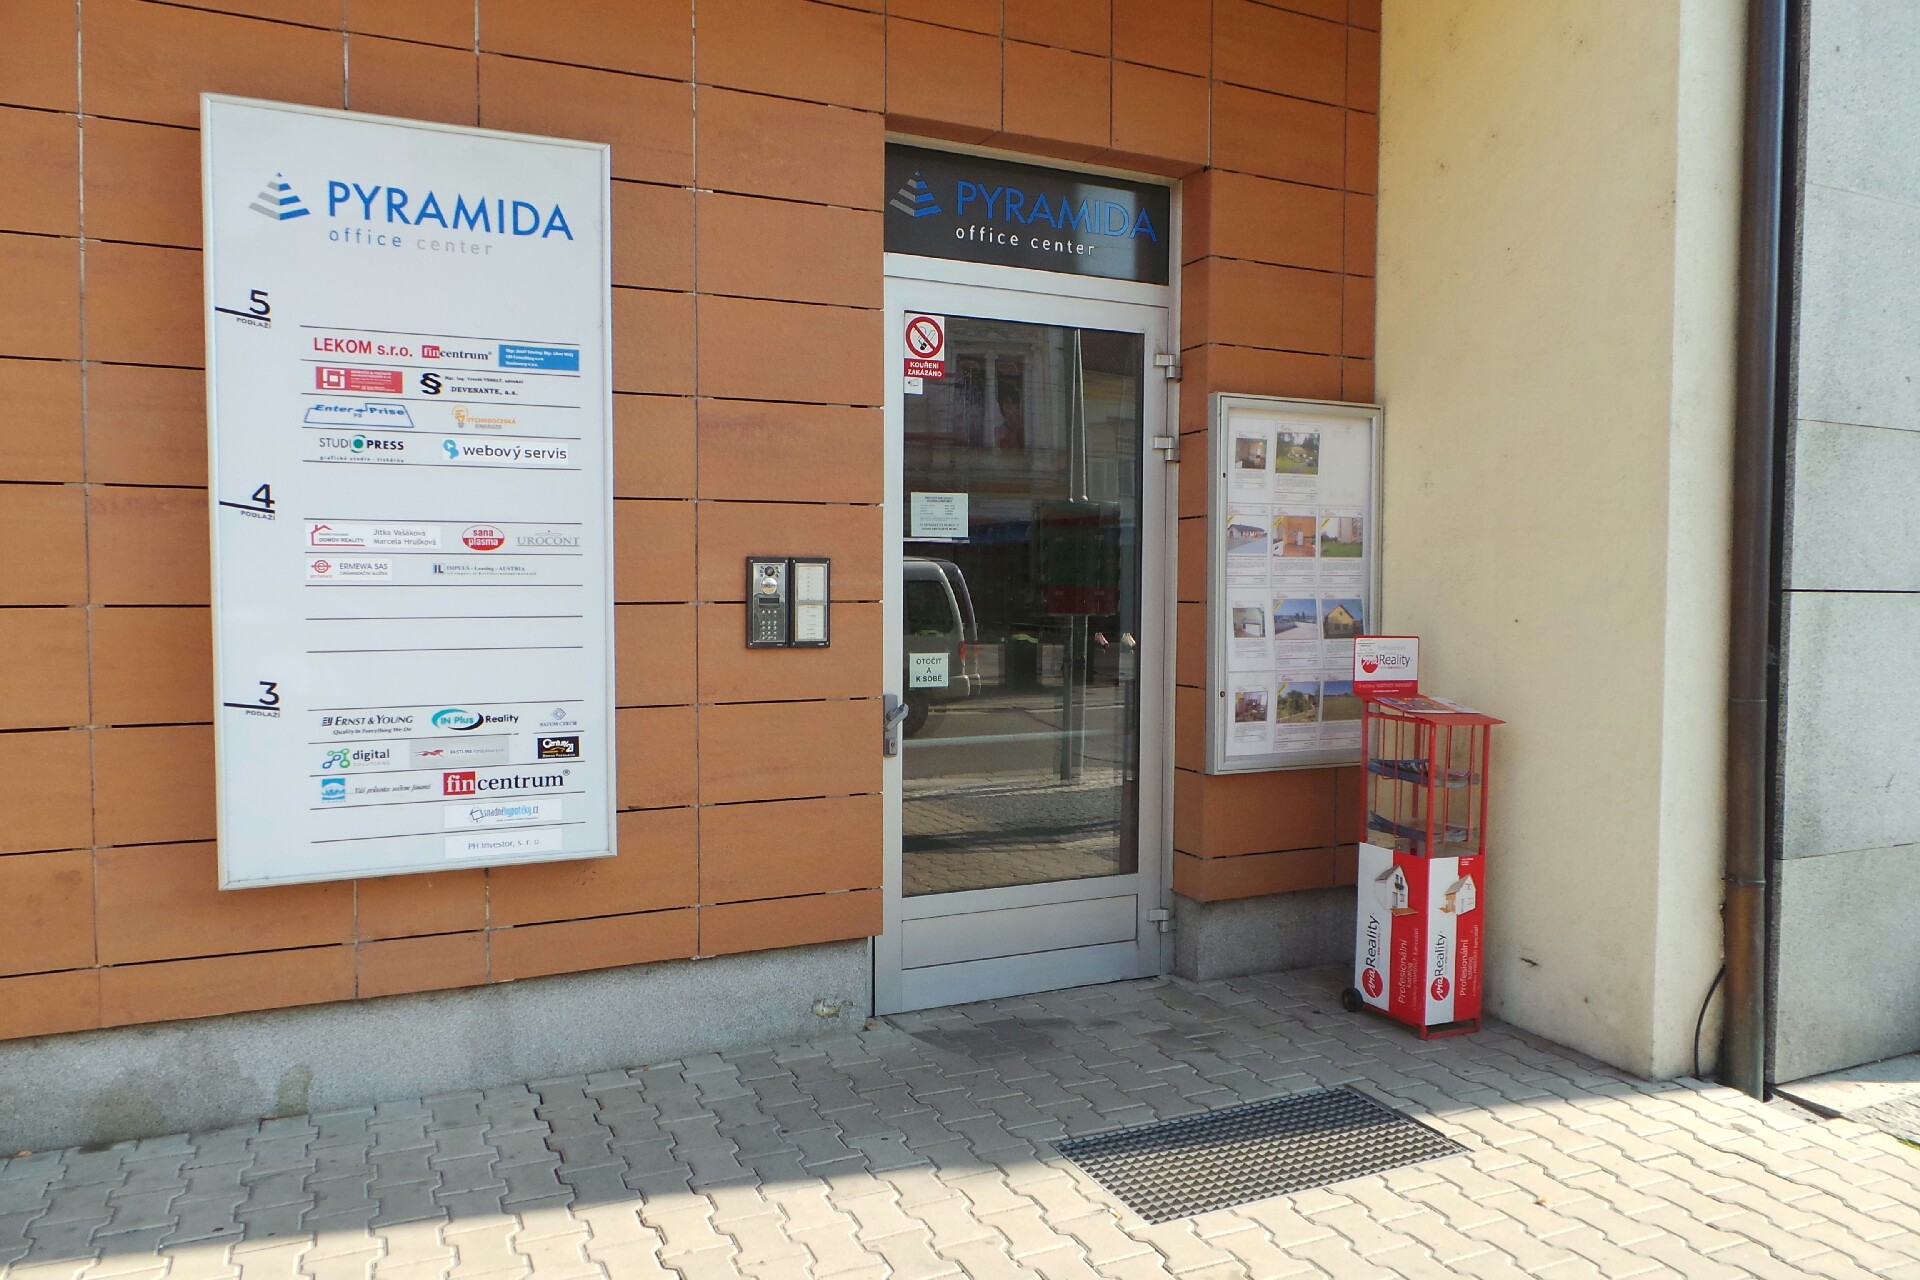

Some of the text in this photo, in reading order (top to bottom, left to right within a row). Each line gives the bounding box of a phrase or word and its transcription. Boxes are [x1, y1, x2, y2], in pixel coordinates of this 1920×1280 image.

[328, 180, 574, 241] PYRAMIDA
[957, 179, 1158, 242] PYRAMIDA
[329, 227, 493, 255] office center
[955, 225, 1095, 256] office center
[249, 289, 271, 315] 5
[313, 337, 413, 357] LEKOM s.r.o.
[909, 361, 940, 369] KOUŘENÍ
[907, 369, 942, 377] ZAKÁZÁNO
[451, 386, 502, 395] DEVENANTE,
[314, 404, 405, 416] Enter Prise
[366, 439, 404, 451] PRESS
[463, 445, 567, 460] webový servis
[252, 483, 275, 508] 4
[473, 529, 494, 537] sana
[468, 537, 499, 547] plasma
[339, 562, 388, 570] ERMEWA SAS
[916, 657, 942, 665] OTOČIT
[1379, 654, 1411, 668] Reality
[922, 674, 943, 682] SOBĚ
[258, 680, 280, 705] 3
[335, 716, 365, 726] ERNST
[367, 717, 375, 725] &
[376, 715, 413, 724] YOUNG
[454, 715, 474, 724] Plus
[485, 714, 519, 724] Reality
[352, 748, 390, 762] digital
[445, 773, 564, 793] fincentrum
[1365, 916, 1381, 968] Reality
[1435, 933, 1447, 977] Reality
[1399, 939, 1407, 1004] Profesionální
[1459, 939, 1469, 996] Profesionální
